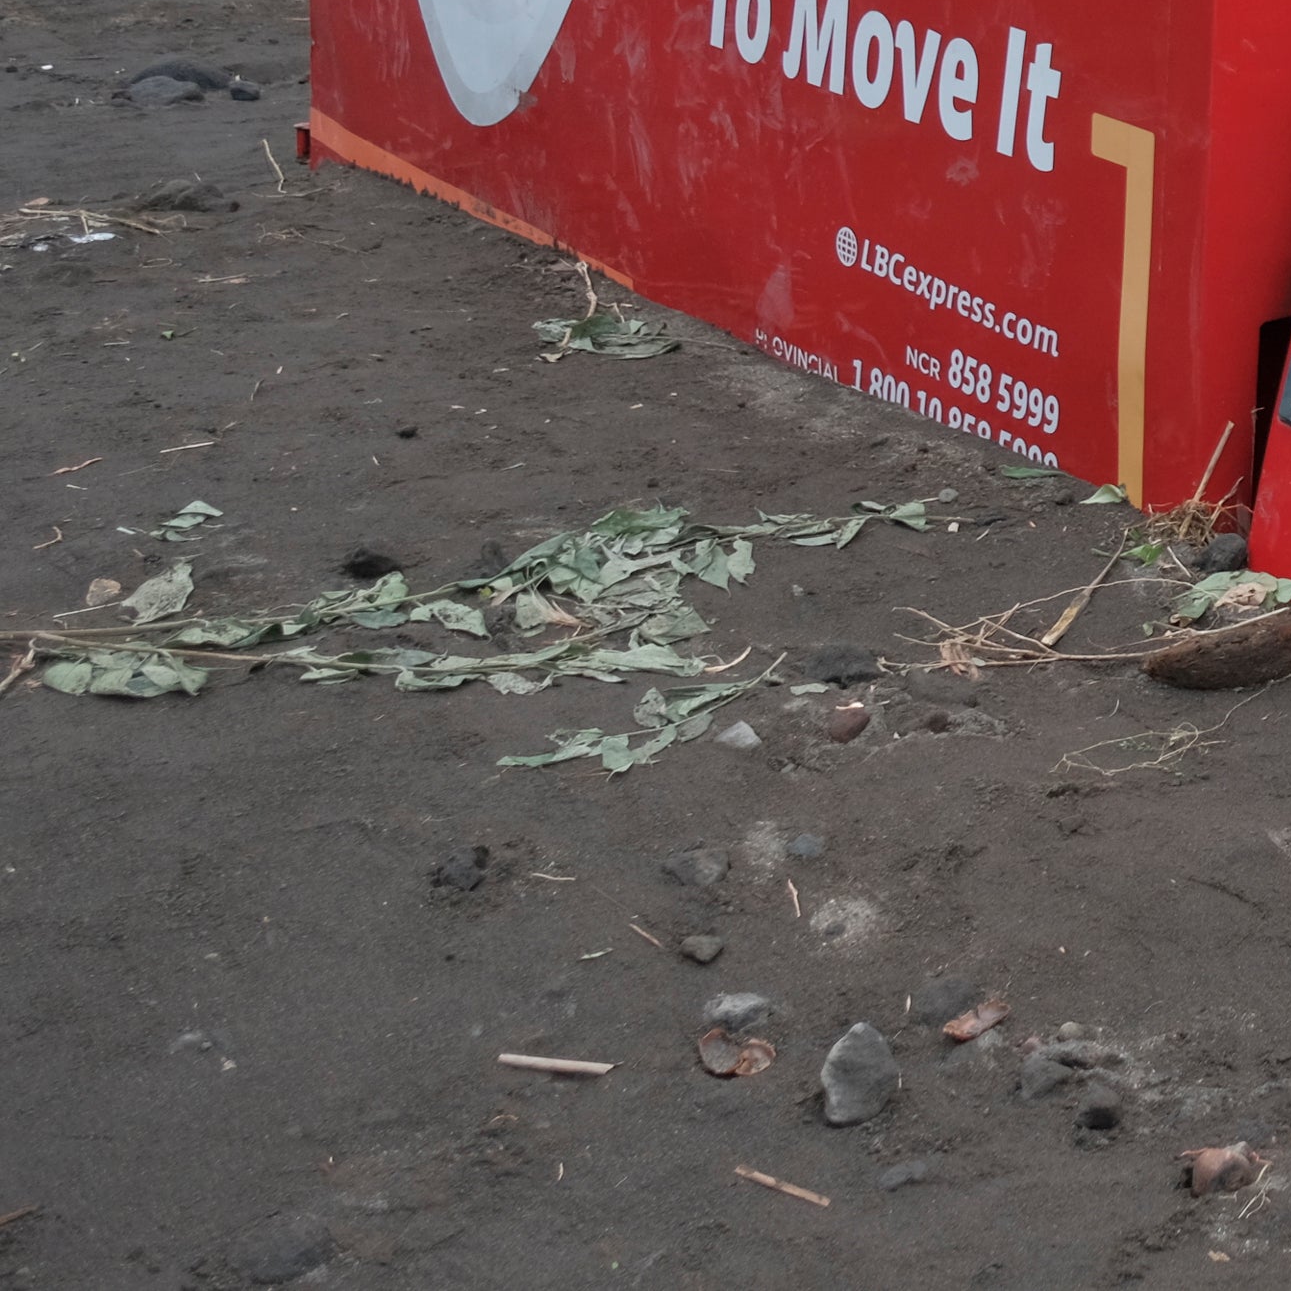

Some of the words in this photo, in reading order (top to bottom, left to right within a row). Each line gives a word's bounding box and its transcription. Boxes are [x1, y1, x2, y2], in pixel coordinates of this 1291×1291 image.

[996, 26, 1062, 172] It
[860, 239, 1059, 357] LBCexpress.com
[851, 359, 863, 392] 1
[906, 345, 941, 381] NCR
[948, 349, 992, 403] 858
[996, 373, 1059, 434] 5999
